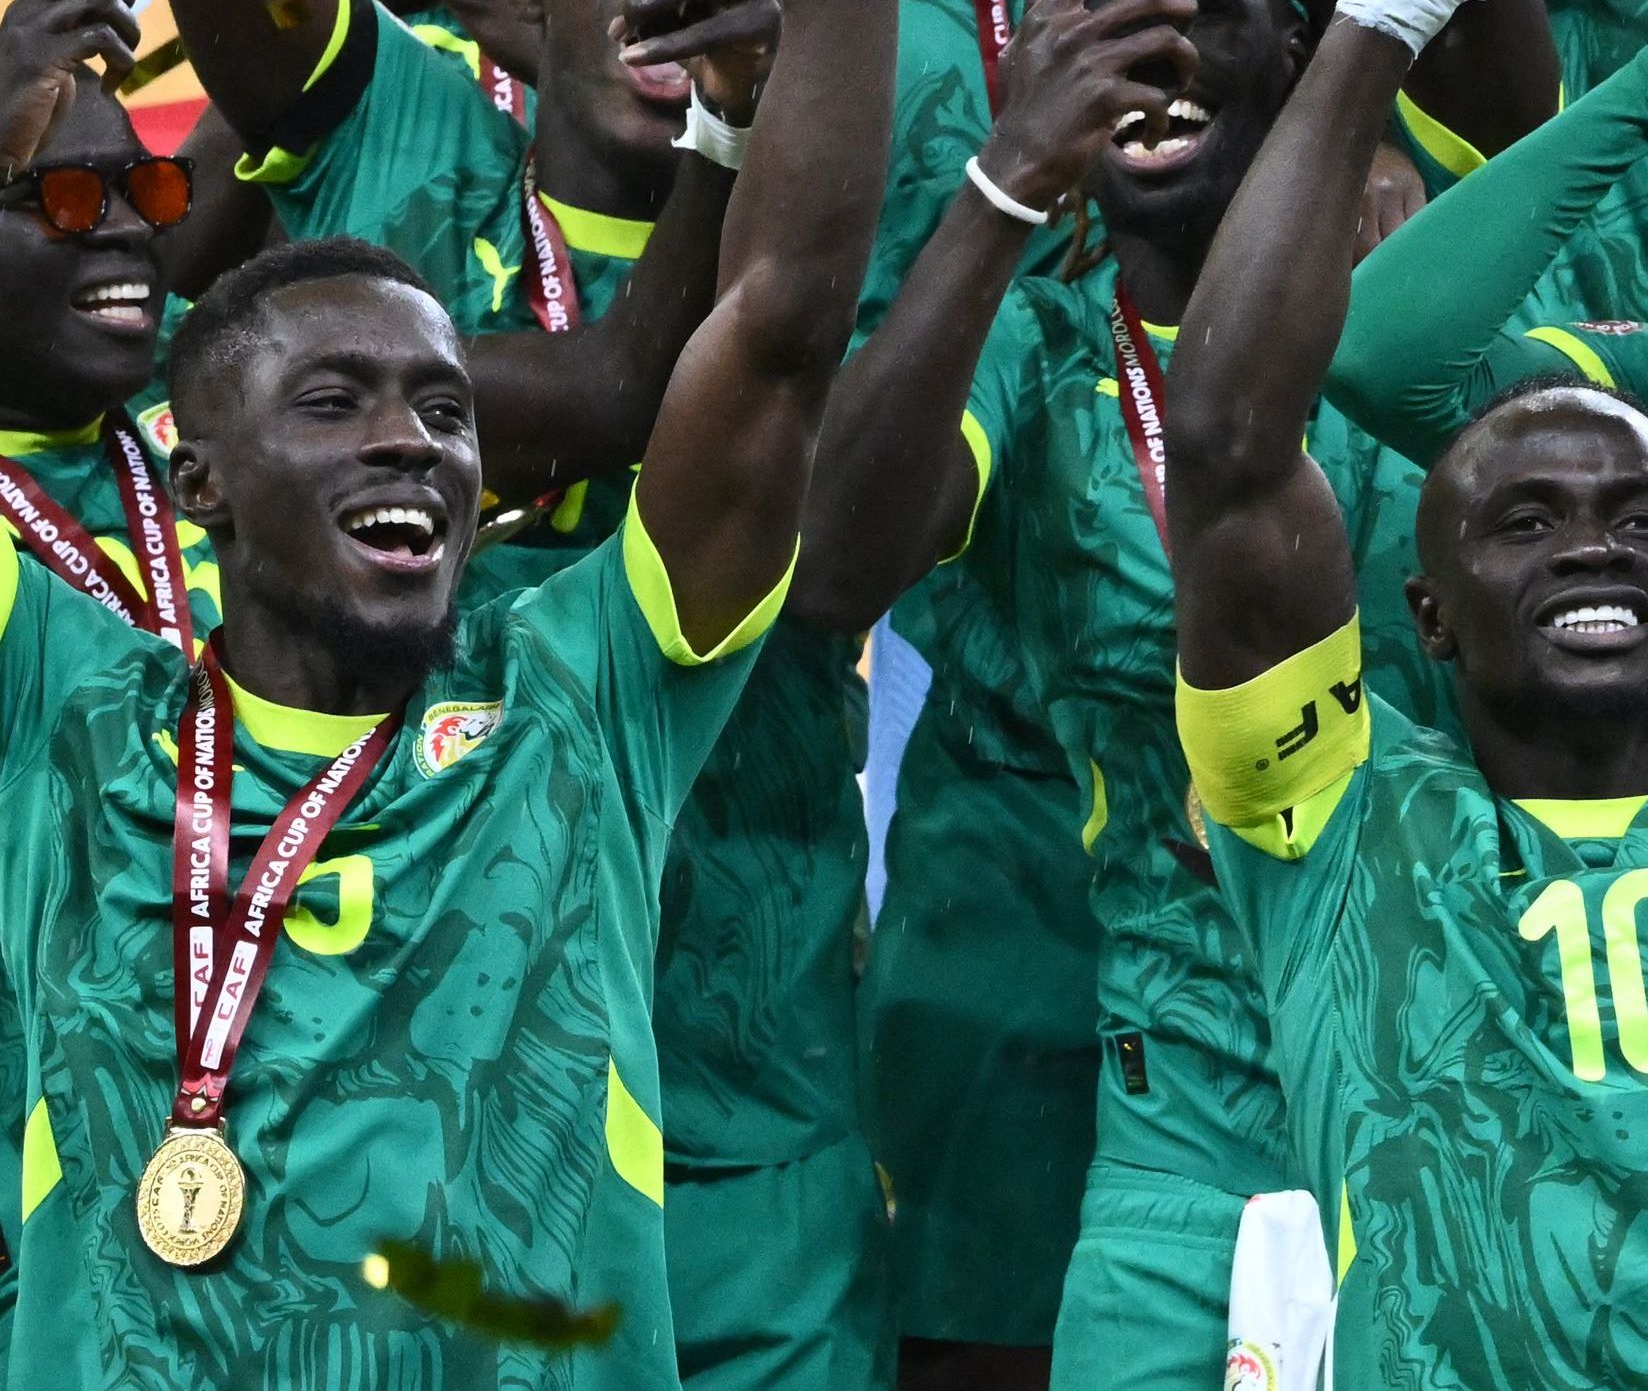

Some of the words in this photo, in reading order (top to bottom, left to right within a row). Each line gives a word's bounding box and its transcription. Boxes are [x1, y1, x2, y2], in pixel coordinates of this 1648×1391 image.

[540, 275, 563, 305] OF
[1126, 367, 1163, 437] NATIONS
[138, 490, 159, 519] OF
[30, 518, 59, 542] OF
[143, 519, 166, 556] CUP
[52, 540, 88, 575] CUP
[151, 557, 177, 623] AFRICA
[194, 766, 215, 792] OF
[191, 792, 213, 835] CUP
[243, 859, 290, 938] AFRICA
[277, 816, 311, 861] CUP
[299, 789, 328, 820] OF
[318, 726, 378, 793] NATIONS
[190, 835, 212, 918] AFRICA
[218, 954, 248, 1020] CAF
[151, 1175, 165, 1207] CAF
[179, 1153, 210, 1167] AFRICA
[201, 1200, 228, 1241] NATIONS
